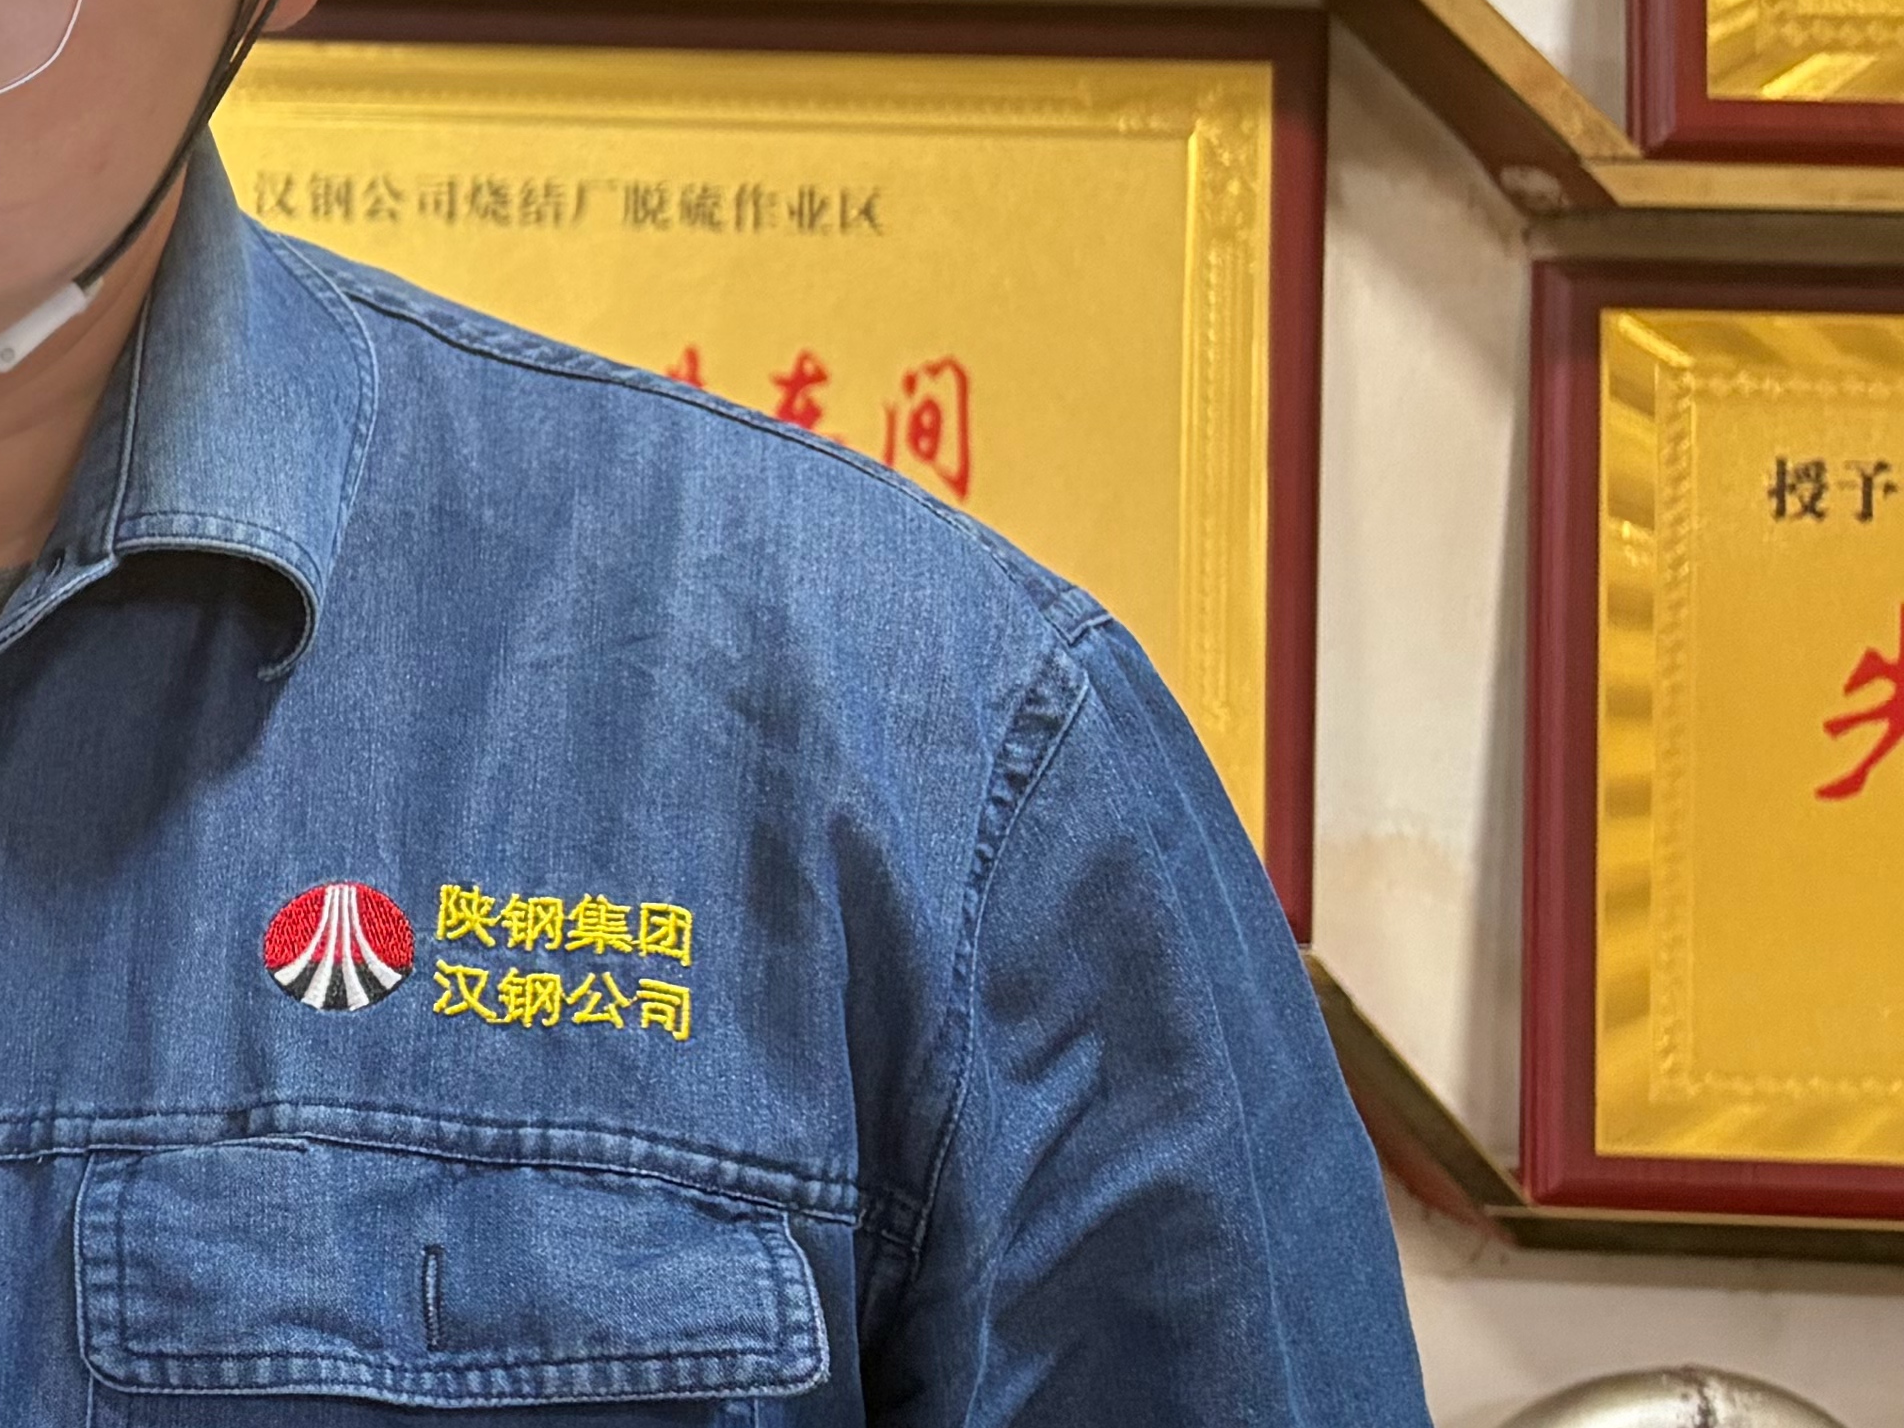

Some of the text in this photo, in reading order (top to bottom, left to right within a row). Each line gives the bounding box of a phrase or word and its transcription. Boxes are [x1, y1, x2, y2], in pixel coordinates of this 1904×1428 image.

[435, 884, 694, 967] 陕钢集团
[432, 959, 692, 1042] 汉钢公司
